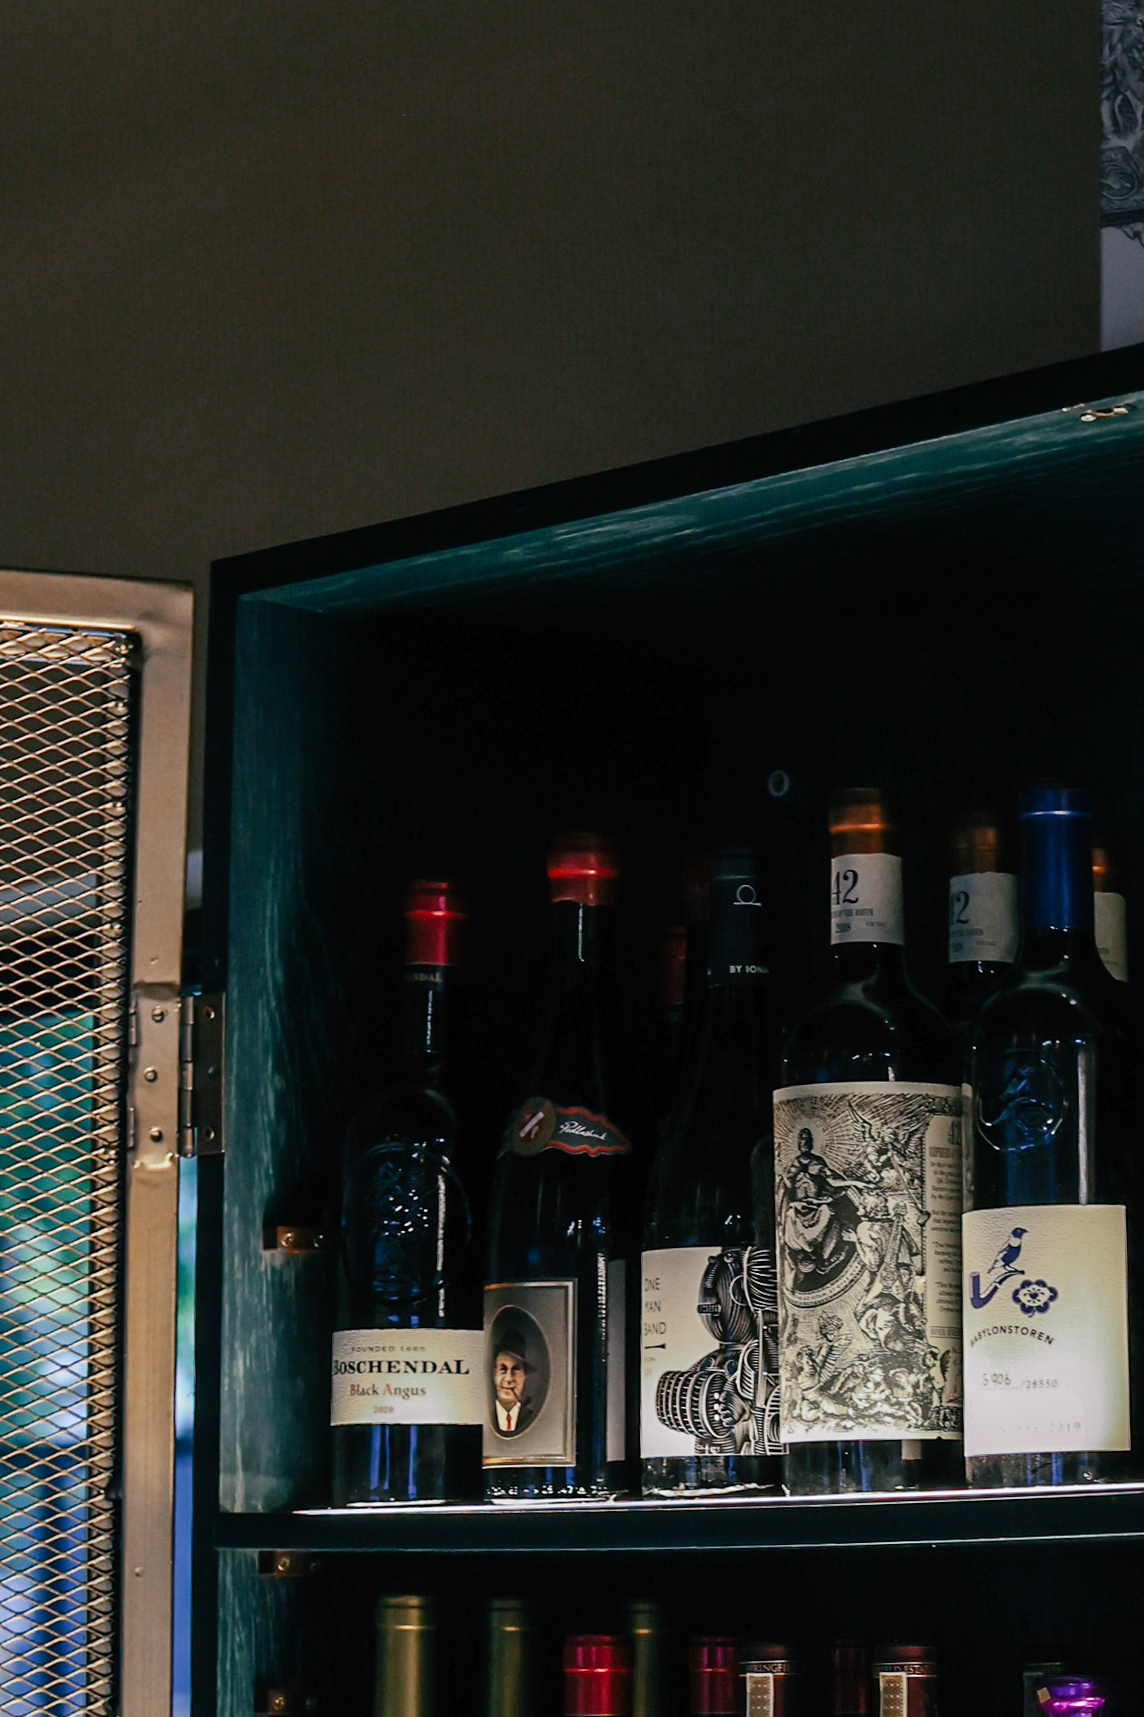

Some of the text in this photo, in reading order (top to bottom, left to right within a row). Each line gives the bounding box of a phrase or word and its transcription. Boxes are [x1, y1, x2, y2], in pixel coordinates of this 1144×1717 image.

[831, 869, 859, 905] 42
[729, 965, 742, 974] BY
[970, 1325, 1055, 1348] BABYLONSTOREN
[333, 1359, 470, 1375] BOSCHENDAL
[349, 1383, 427, 1401] Black Angus
